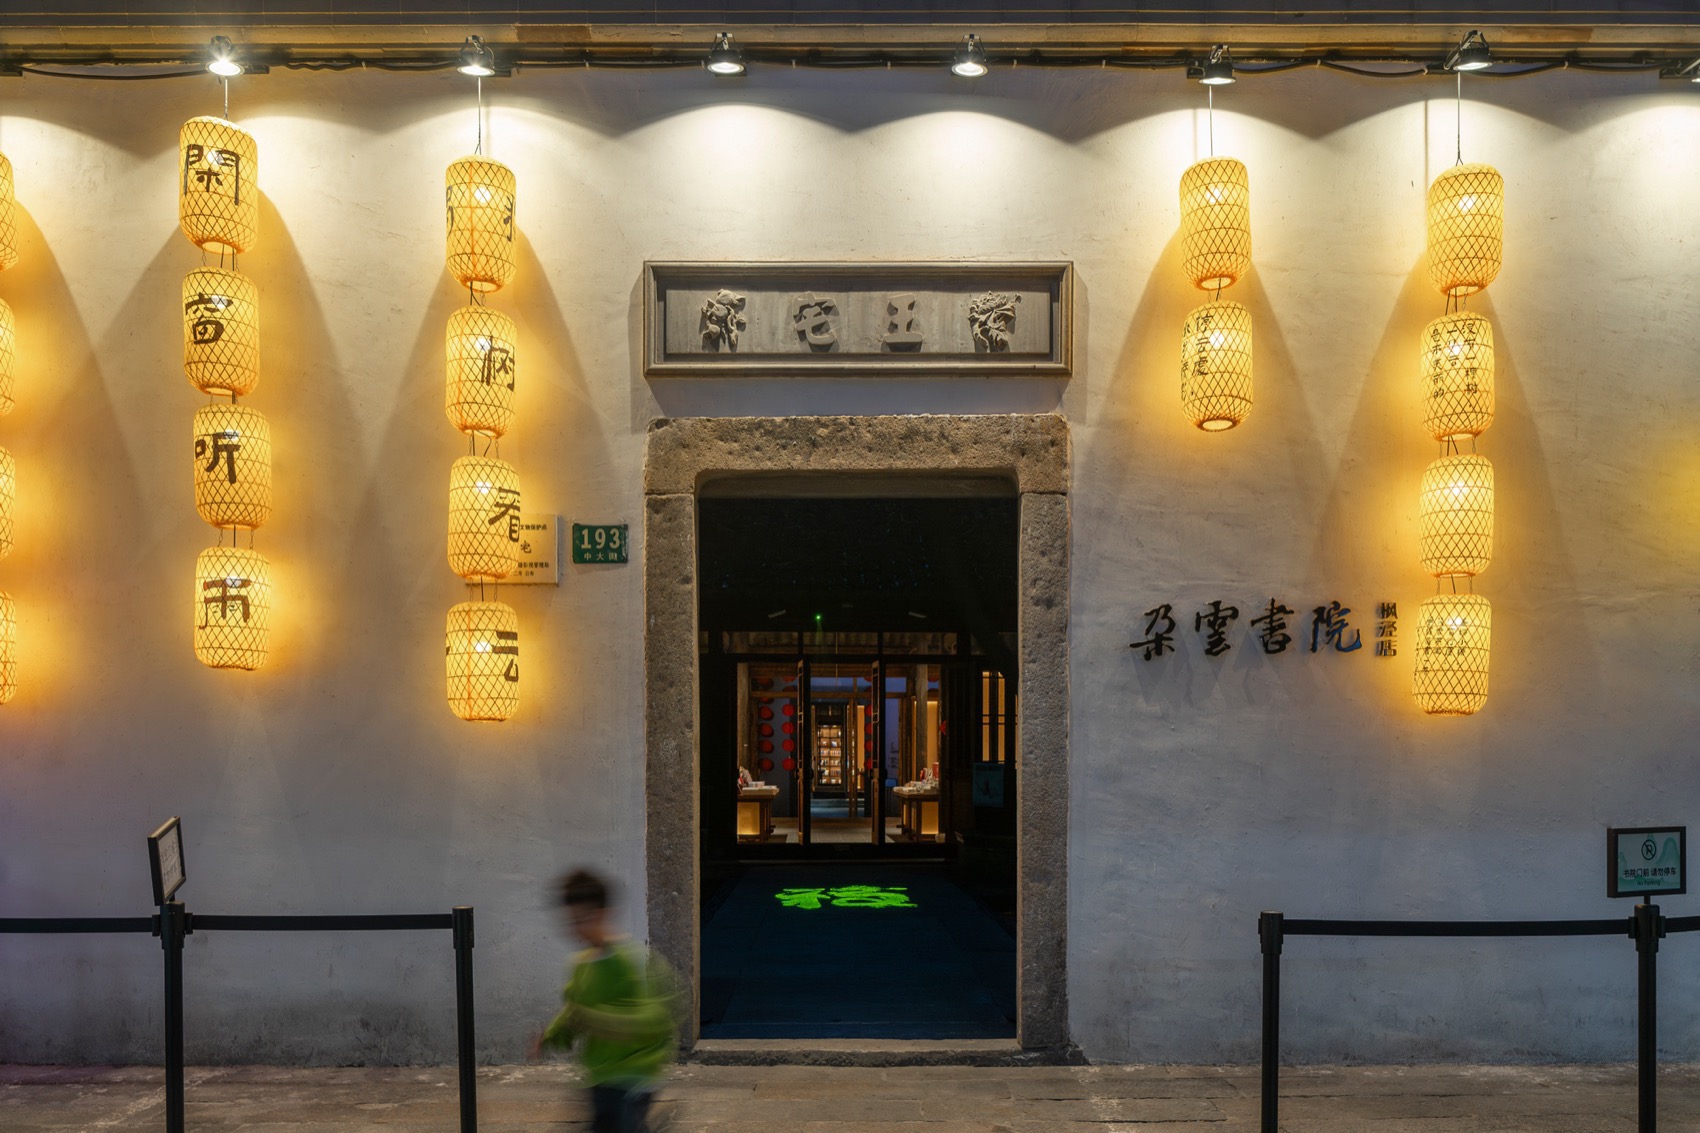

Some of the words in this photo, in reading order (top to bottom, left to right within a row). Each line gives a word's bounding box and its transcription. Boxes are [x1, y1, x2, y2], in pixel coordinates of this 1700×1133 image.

[581, 527, 621, 549] 193
[584, 552, 618, 561] 中大街
[1130, 598, 1362, 661] 朵雲書院
[1375, 602, 1398, 657] 枫泾店
[1651, 866, 1677, 877] 请勿停车
